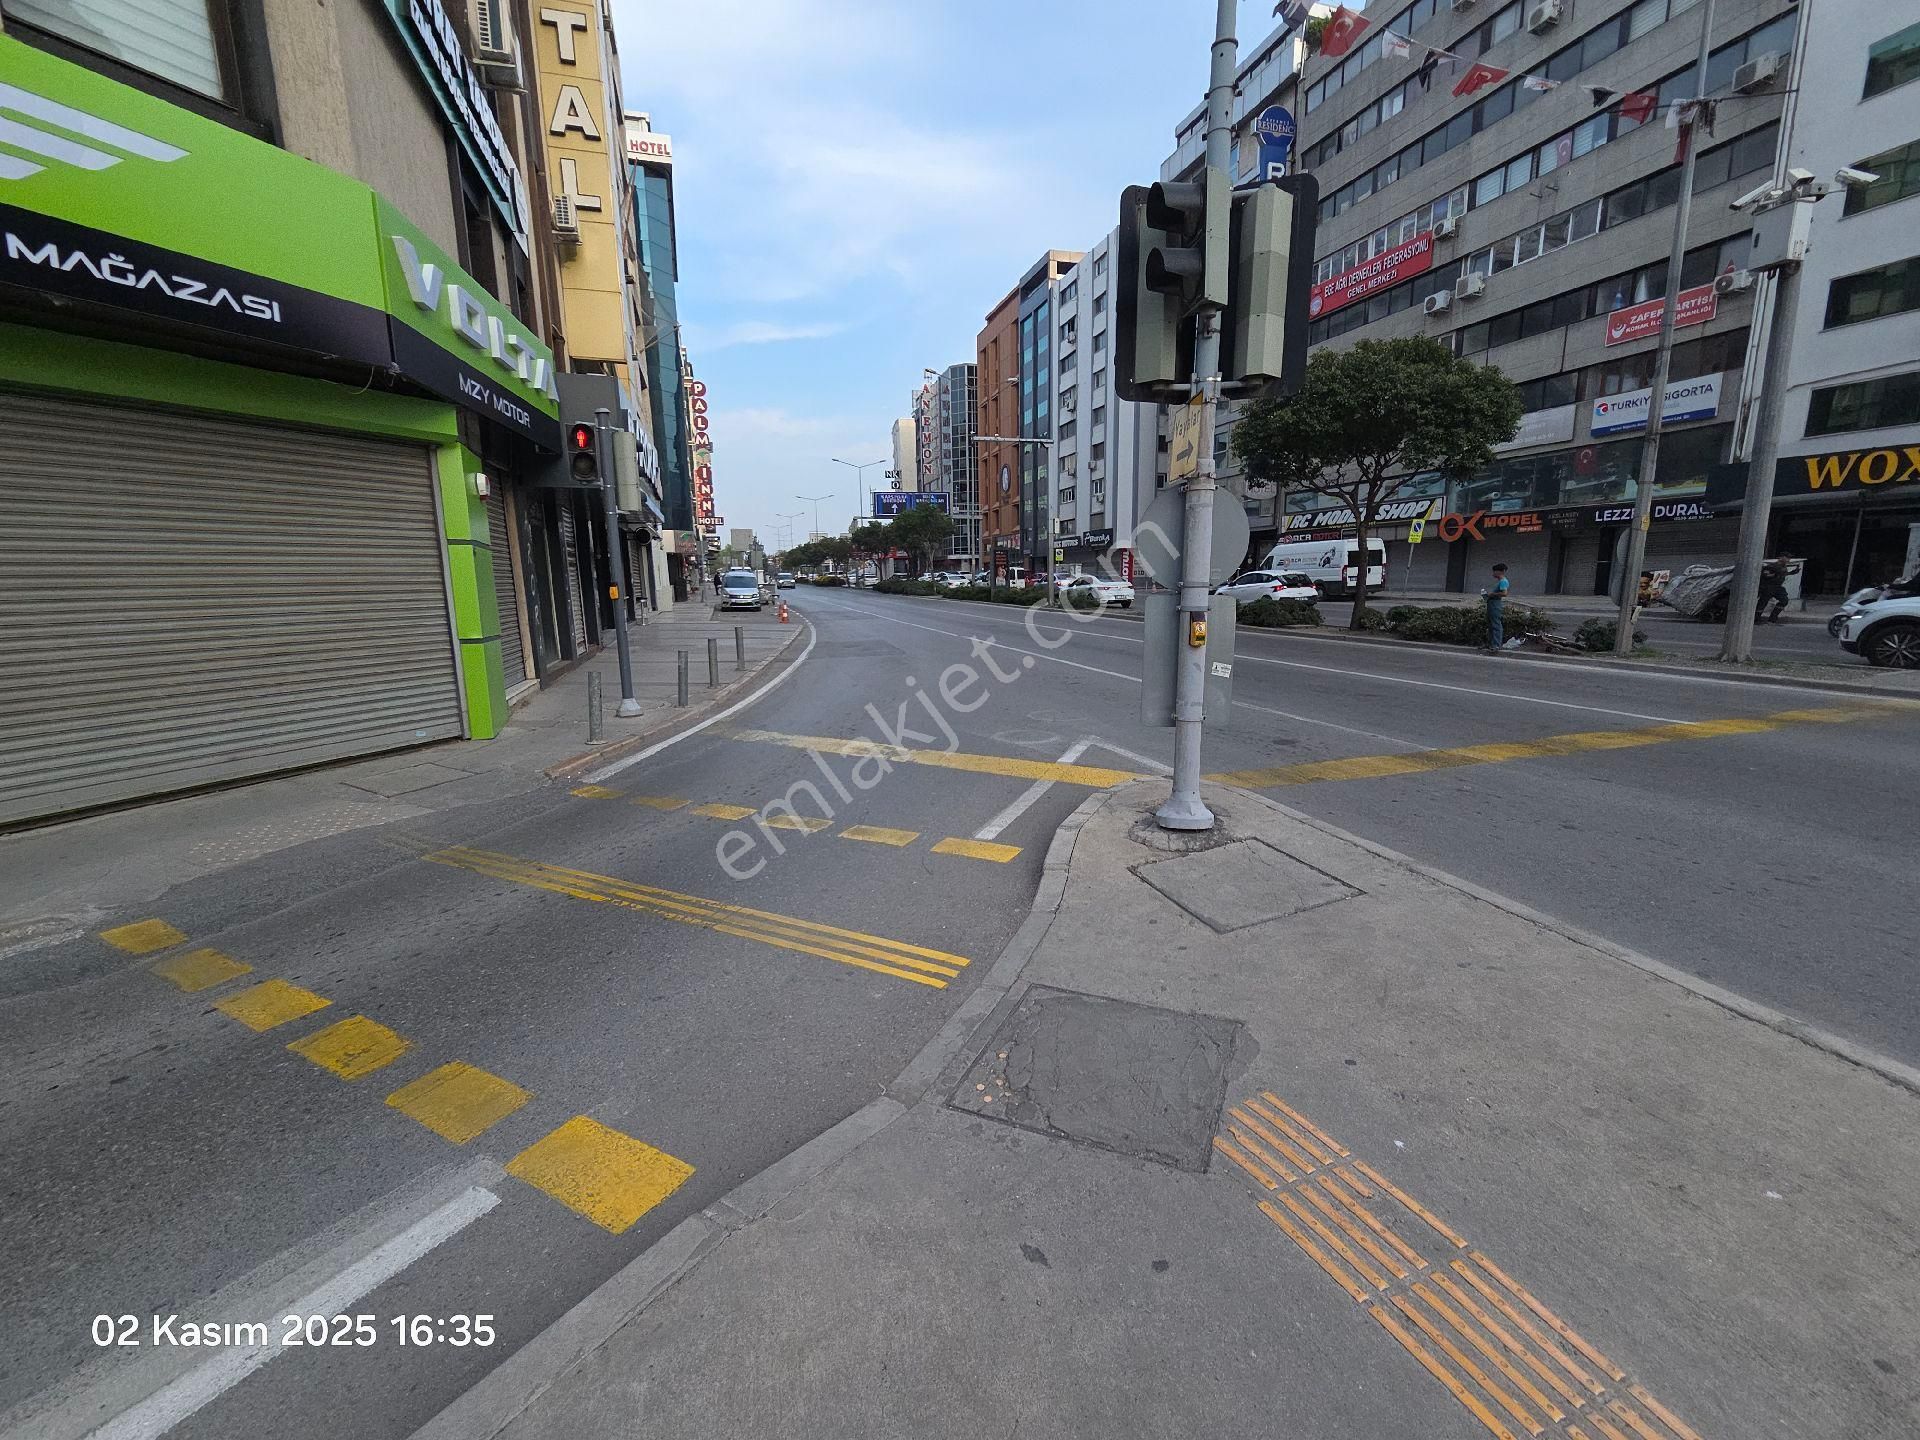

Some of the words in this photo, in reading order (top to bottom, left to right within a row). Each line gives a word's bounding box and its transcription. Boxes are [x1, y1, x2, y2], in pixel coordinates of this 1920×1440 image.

[629, 139, 670, 156] HOTEL
[1383, 238, 1430, 270] FEDERASYONU
[5, 232, 281, 322] MAĞAZASI
[1347, 283, 1368, 299] GENEL
[391, 236, 560, 402] VOLTA
[459, 373, 490, 404] MZY
[493, 394, 531, 427] MOTOR
[695, 383, 708, 446] PALM
[922, 384, 932, 474] ANEMON
[1175, 409, 1201, 439] Yayalar
[701, 465, 713, 510] INN
[699, 517, 724, 526] HOTEL
[1289, 513, 1311, 529] RC
[1374, 500, 1431, 521] SHOP
[1440, 509, 1487, 543] OK
[1484, 513, 1542, 528] MODEL
